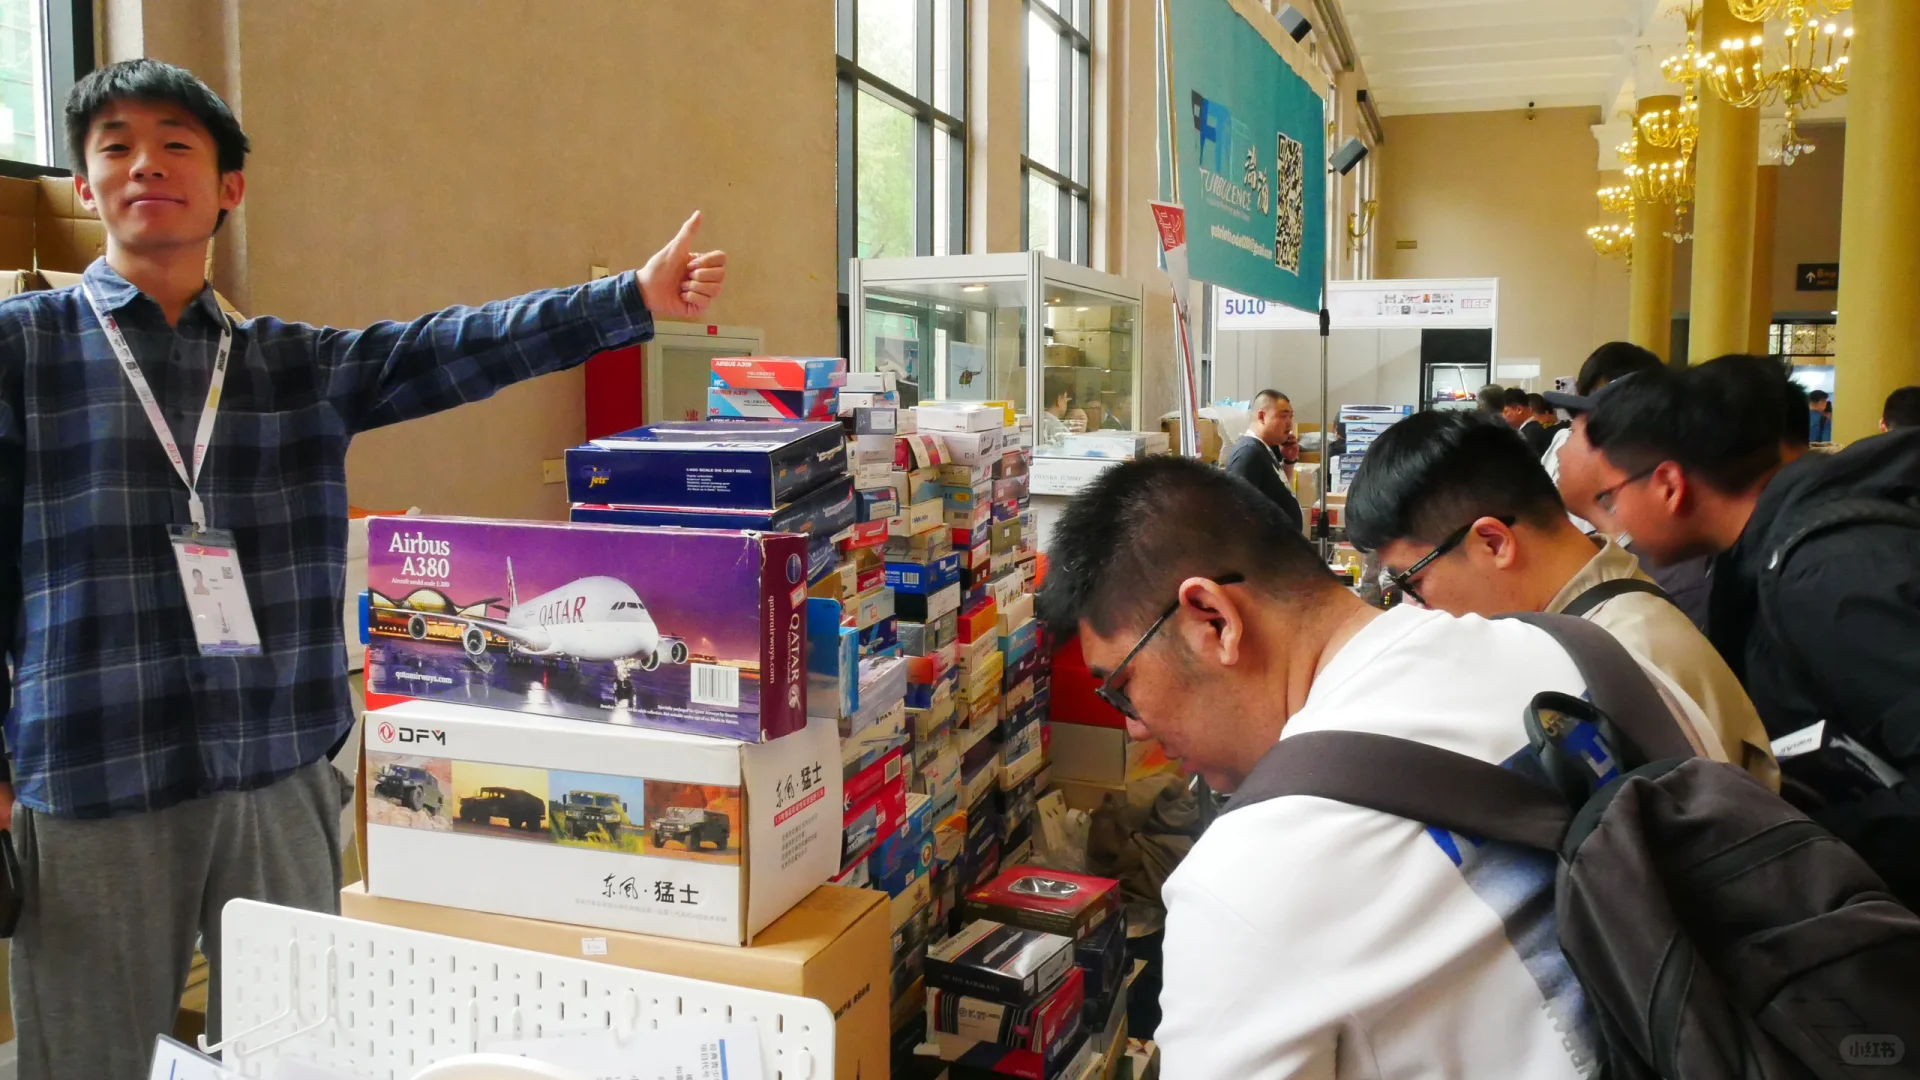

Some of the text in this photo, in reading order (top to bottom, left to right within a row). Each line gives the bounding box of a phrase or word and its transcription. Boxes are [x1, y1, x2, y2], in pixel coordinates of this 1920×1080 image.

[1199, 167, 1251, 211] TURBULENCE
[1225, 299, 1266, 315] 5U10
[715, 360, 736, 368] AIRBUS
[713, 379, 725, 387] NG
[709, 407, 720, 415] NG
[388, 532, 451, 556] Airbus
[401, 556, 450, 578] A380
[539, 596, 586, 631] QATAR
[767, 595, 775, 684] qatarairways.com
[789, 612, 801, 683] QATAR
[398, 727, 446, 746] DFM
